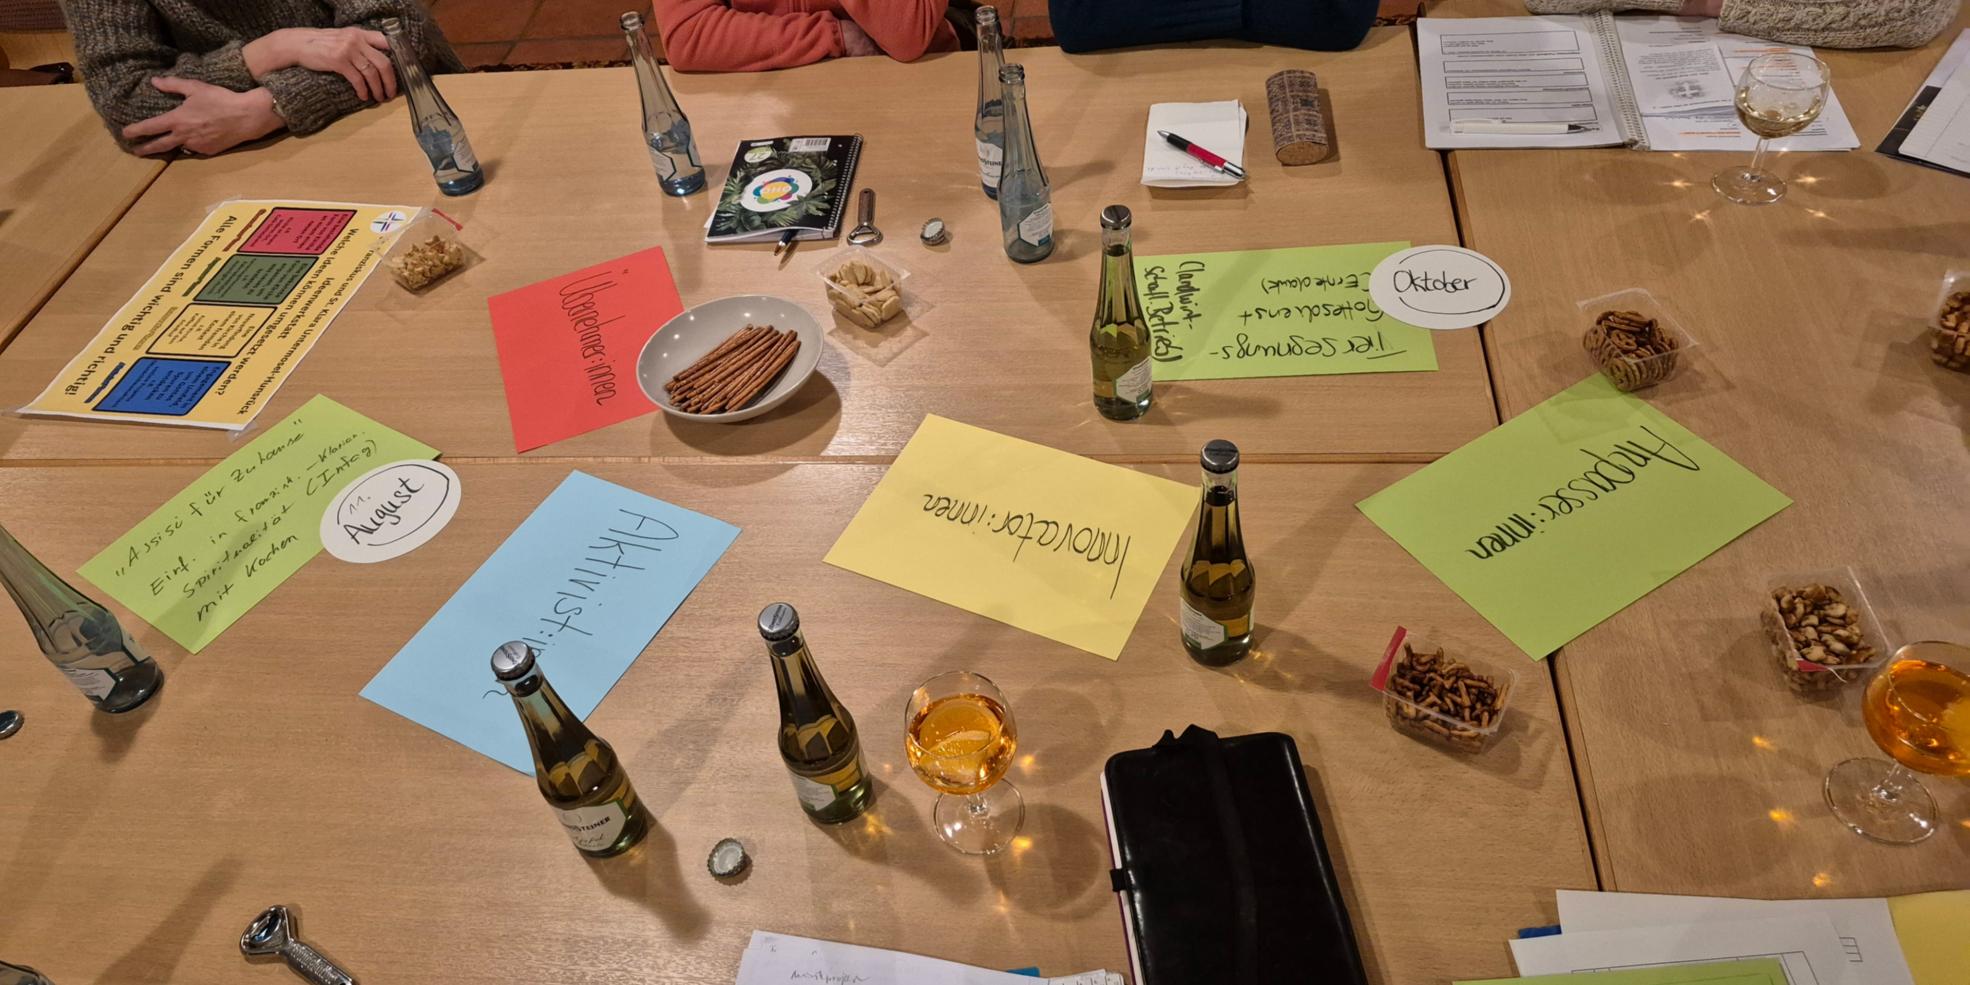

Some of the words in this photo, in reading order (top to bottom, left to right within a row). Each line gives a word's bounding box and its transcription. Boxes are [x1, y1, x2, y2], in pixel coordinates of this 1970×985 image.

[213, 215, 240, 232] Alle
[178, 235, 221, 269] Formen
[328, 228, 359, 255] Welche
[309, 257, 336, 278] Ideen
[344, 246, 381, 281] ranziskus
[157, 272, 188, 292] sind
[282, 279, 318, 310] können
[332, 282, 352, 296] und
[1394, 269, 1477, 293] Oktober
[119, 294, 167, 331] wichtig
[275, 277, 336, 338] Ideenwerkstatt
[307, 309, 330, 327] Klara
[99, 333, 130, 353] und
[243, 311, 291, 355] umgesetzt
[60, 355, 111, 395] richtig!
[211, 356, 254, 395] werden?
[191, 485, 225, 517] für
[1465, 425, 1700, 559] Anpasser:innen
[343, 477, 424, 544] August
[183, 504, 294, 598] Spiritualität
[211, 532, 228, 545] in
[922, 494, 1131, 600] Innovator:innen
[197, 582, 234, 621] mit
[245, 535, 298, 577] Kochen
